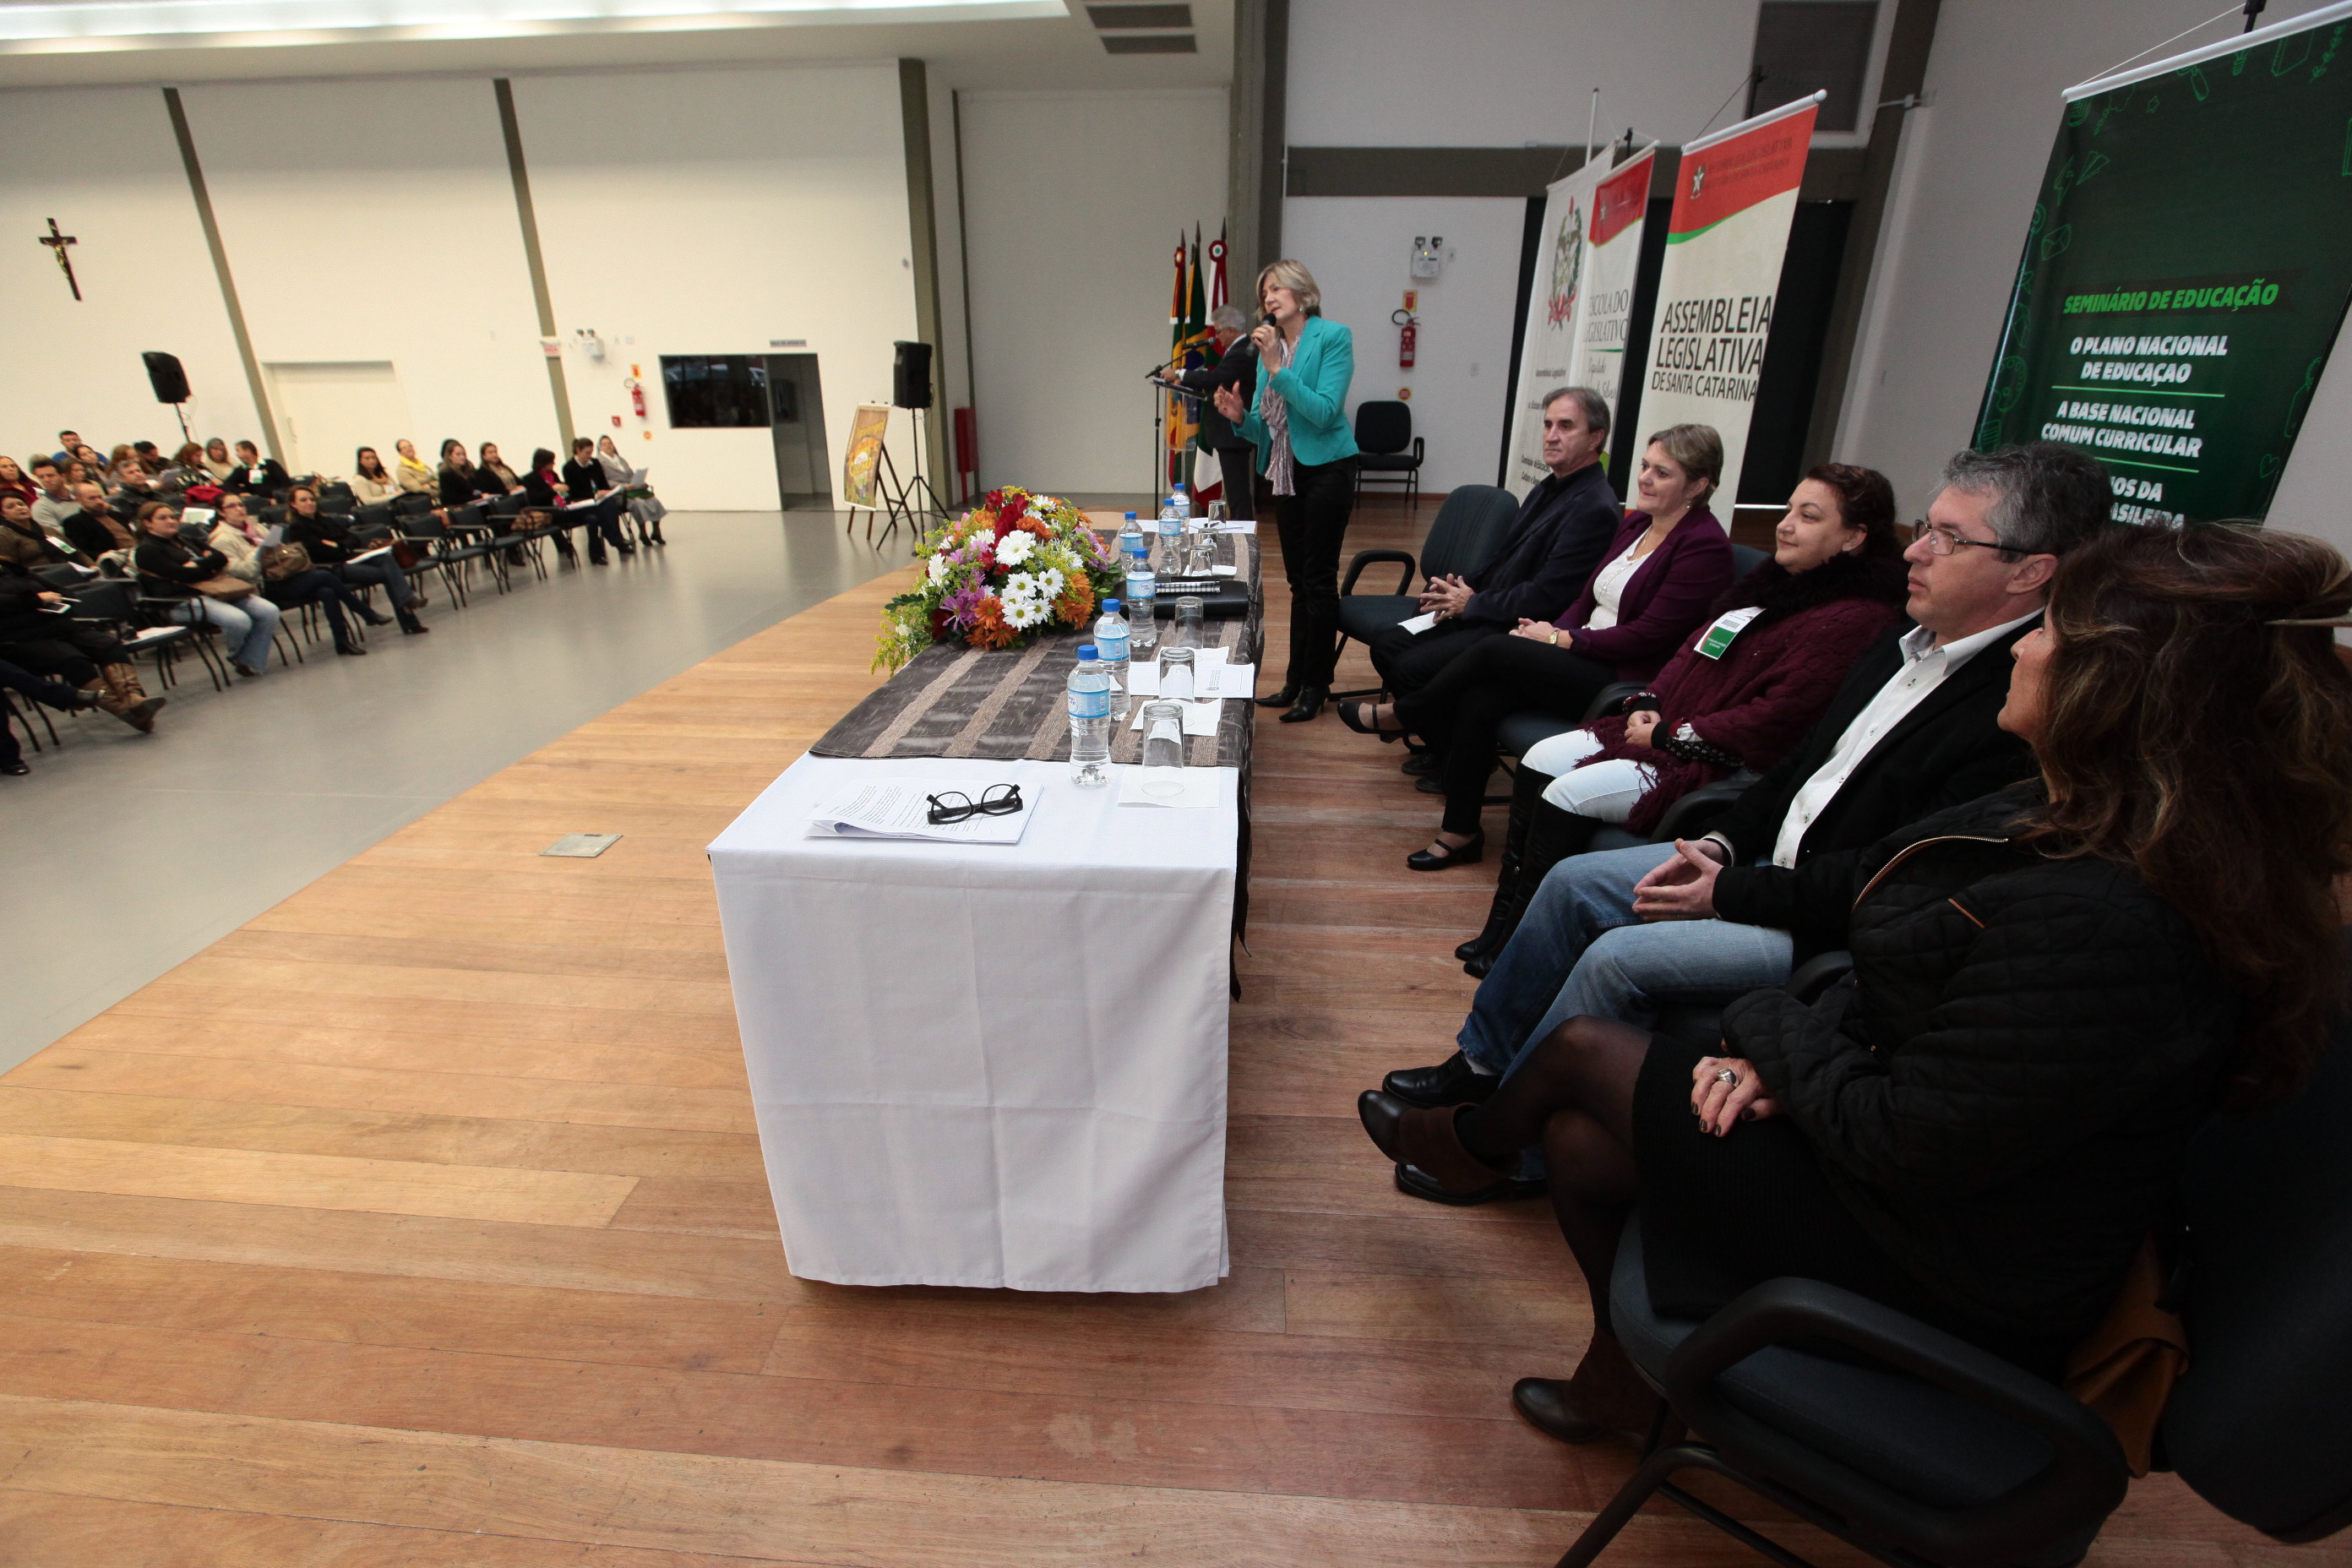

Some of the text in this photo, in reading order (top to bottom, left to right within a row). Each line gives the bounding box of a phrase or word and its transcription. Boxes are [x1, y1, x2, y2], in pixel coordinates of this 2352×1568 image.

[2062, 278, 2279, 314] SEMINÁRIO DE EDUCAÇÃO
[1660, 296, 1772, 334] ASSEMBLEIA
[1656, 337, 1764, 375] LEGISLATIVA
[2070, 335, 2229, 357] O PLANO NACIONAL
[1652, 371, 1757, 401] DE SANTA CATARINA
[2080, 362, 2103, 380] DE
[2055, 400, 2196, 430] A BASE NACIONAL
[2040, 422, 2203, 458] COMUM CURRICULAR
[2136, 481, 2163, 502] DA
